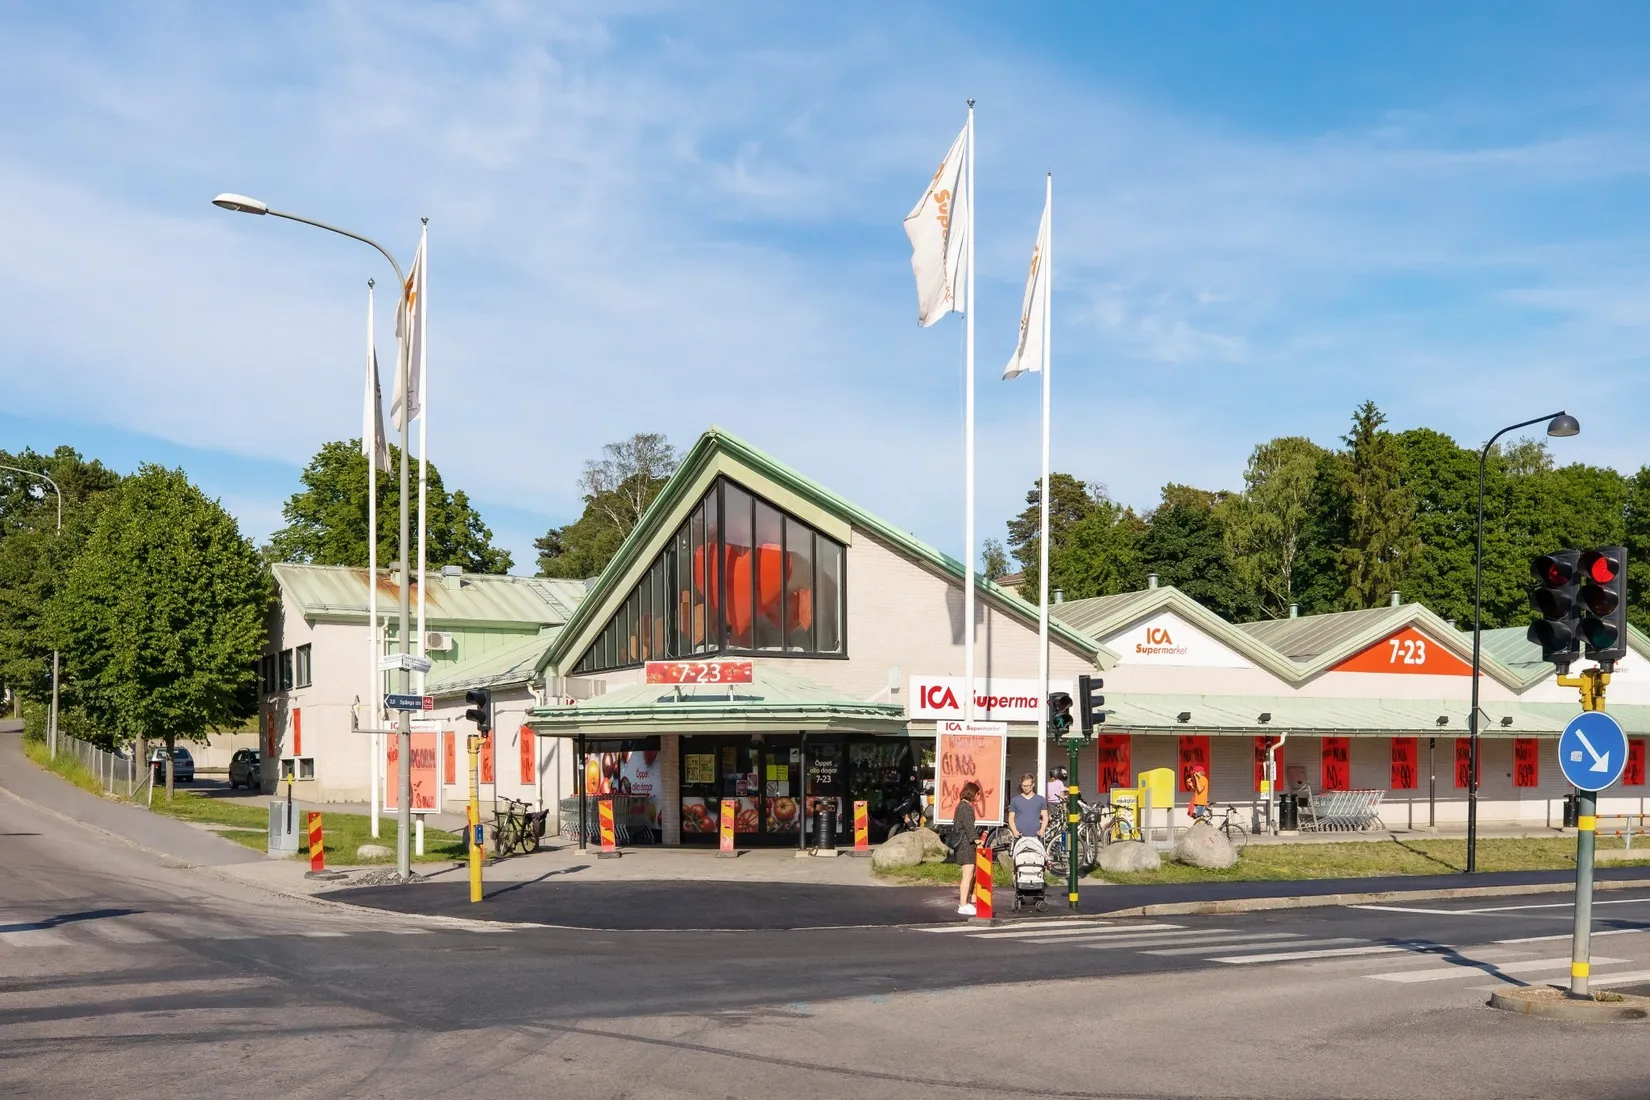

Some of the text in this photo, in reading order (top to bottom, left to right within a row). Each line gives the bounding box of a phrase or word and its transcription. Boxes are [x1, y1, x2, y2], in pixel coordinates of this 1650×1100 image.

[1146, 627, 1173, 645] ICA
[1135, 643, 1188, 656] Supermarket
[1388, 639, 1426, 665] 7-23
[677, 663, 721, 683] 7-23
[920, 685, 1039, 711] ICA uperma
[945, 722, 1001, 732] ICA Supermarket
[820, 767, 838, 775] dagar
[815, 775, 832, 783] 7-23
